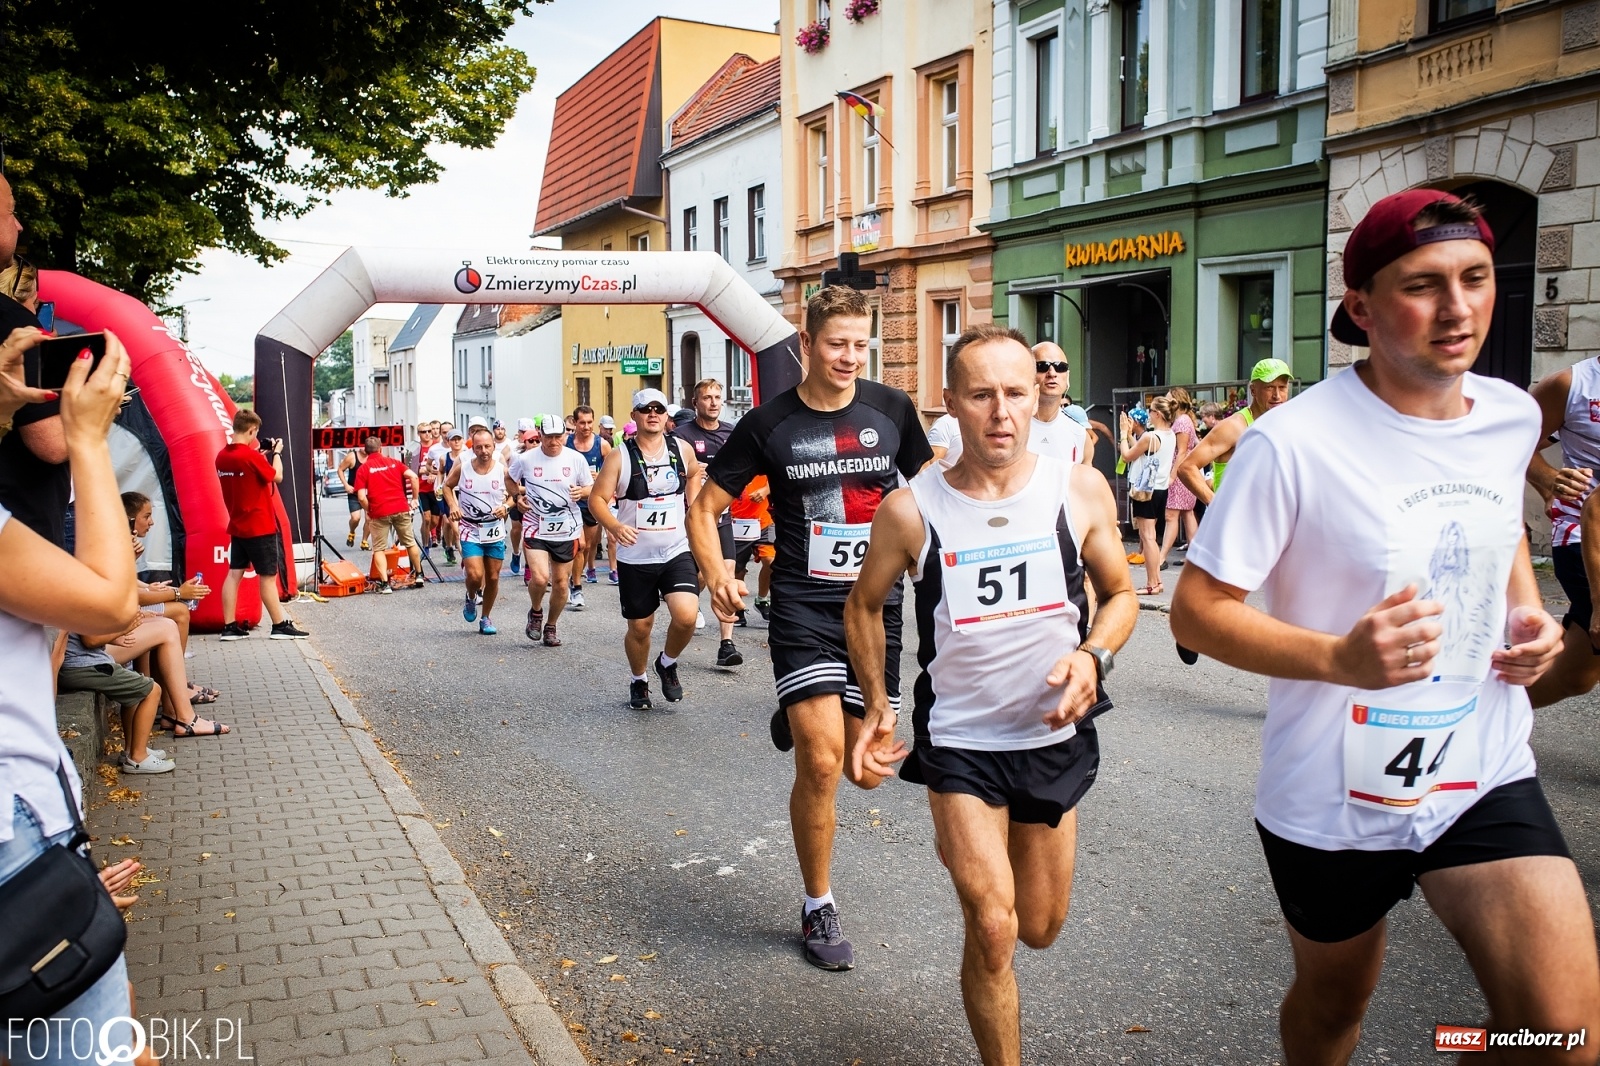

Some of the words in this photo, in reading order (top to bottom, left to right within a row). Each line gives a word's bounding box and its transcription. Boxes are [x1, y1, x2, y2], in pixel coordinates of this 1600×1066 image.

[1065, 230, 1186, 269] KWIACIARNIA
[486, 256, 559, 268] Elektroniczny
[562, 258, 598, 268] pomiar
[485, 274, 637, 295] ZmierzymyCzas.pl
[1545, 277, 1559, 300] 5
[785, 455, 890, 480] RUNMAGEDDON
[1403, 488, 1429, 508] BIEG
[1430, 483, 1504, 506] KRZANOWICKI
[547, 521, 564, 533] 37
[646, 510, 668, 526] 41
[486, 526, 500, 538] 46
[742, 525, 751, 536] 7
[828, 528, 843, 537] BIEG
[843, 527, 871, 537] KRZANO
[829, 540, 870, 568] 59
[959, 554, 963, 563] I
[964, 550, 986, 562] BIEG
[987, 539, 1052, 559] KRZANOWICKI
[977, 560, 1027, 606] 51
[1371, 711, 1376, 722] I
[1378, 713, 1409, 726] BIEG
